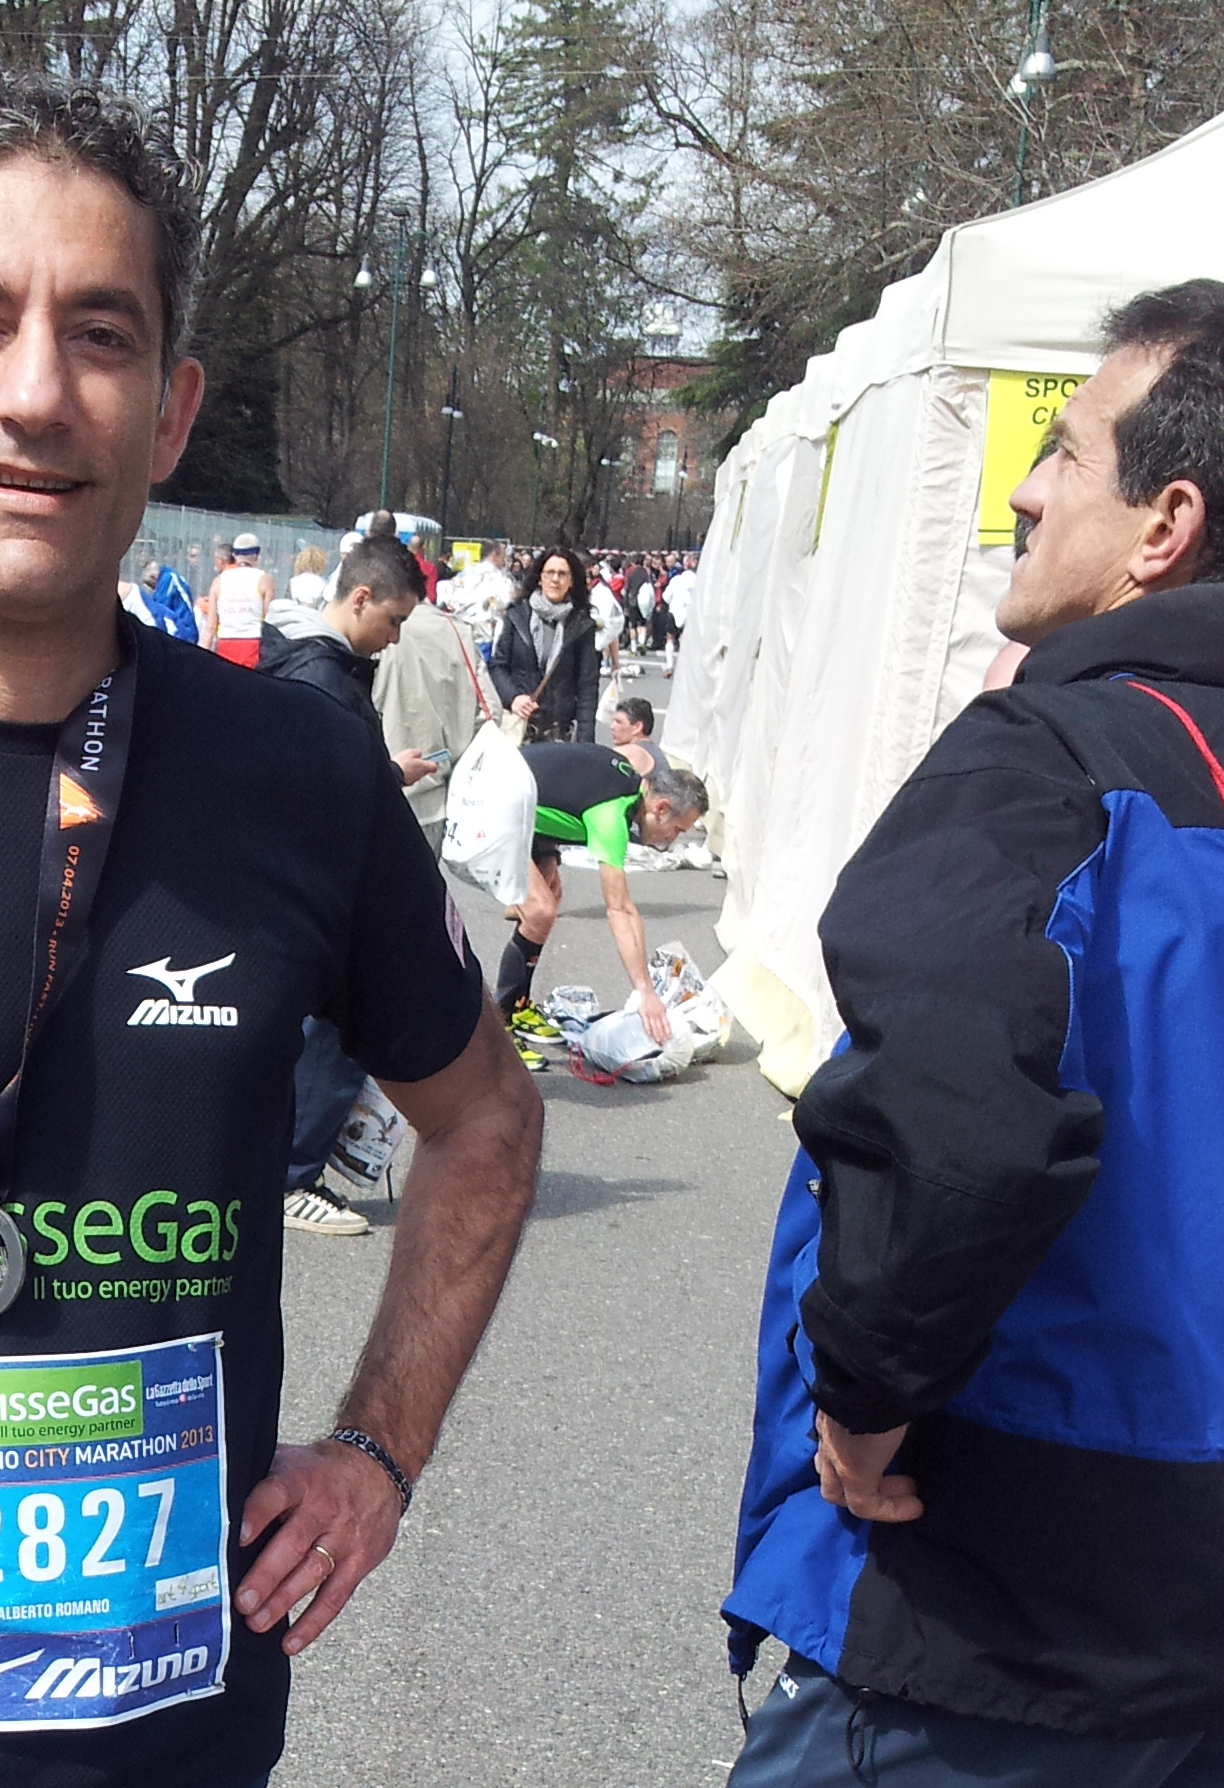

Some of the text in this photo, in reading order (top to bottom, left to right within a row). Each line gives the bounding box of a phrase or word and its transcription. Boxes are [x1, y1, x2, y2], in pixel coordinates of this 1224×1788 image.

[54, 844, 81, 928] 07.04.2013
[51, 1278, 94, 1300] tuo
[98, 1278, 172, 1304] energy
[0, 1418, 136, 1438] Il tuo energy partner
[24, 1446, 70, 1469] CITY
[74, 1432, 178, 1466] MARATHON
[180, 1424, 214, 1450] 2013
[55, 1599, 110, 1617] ROMANO
